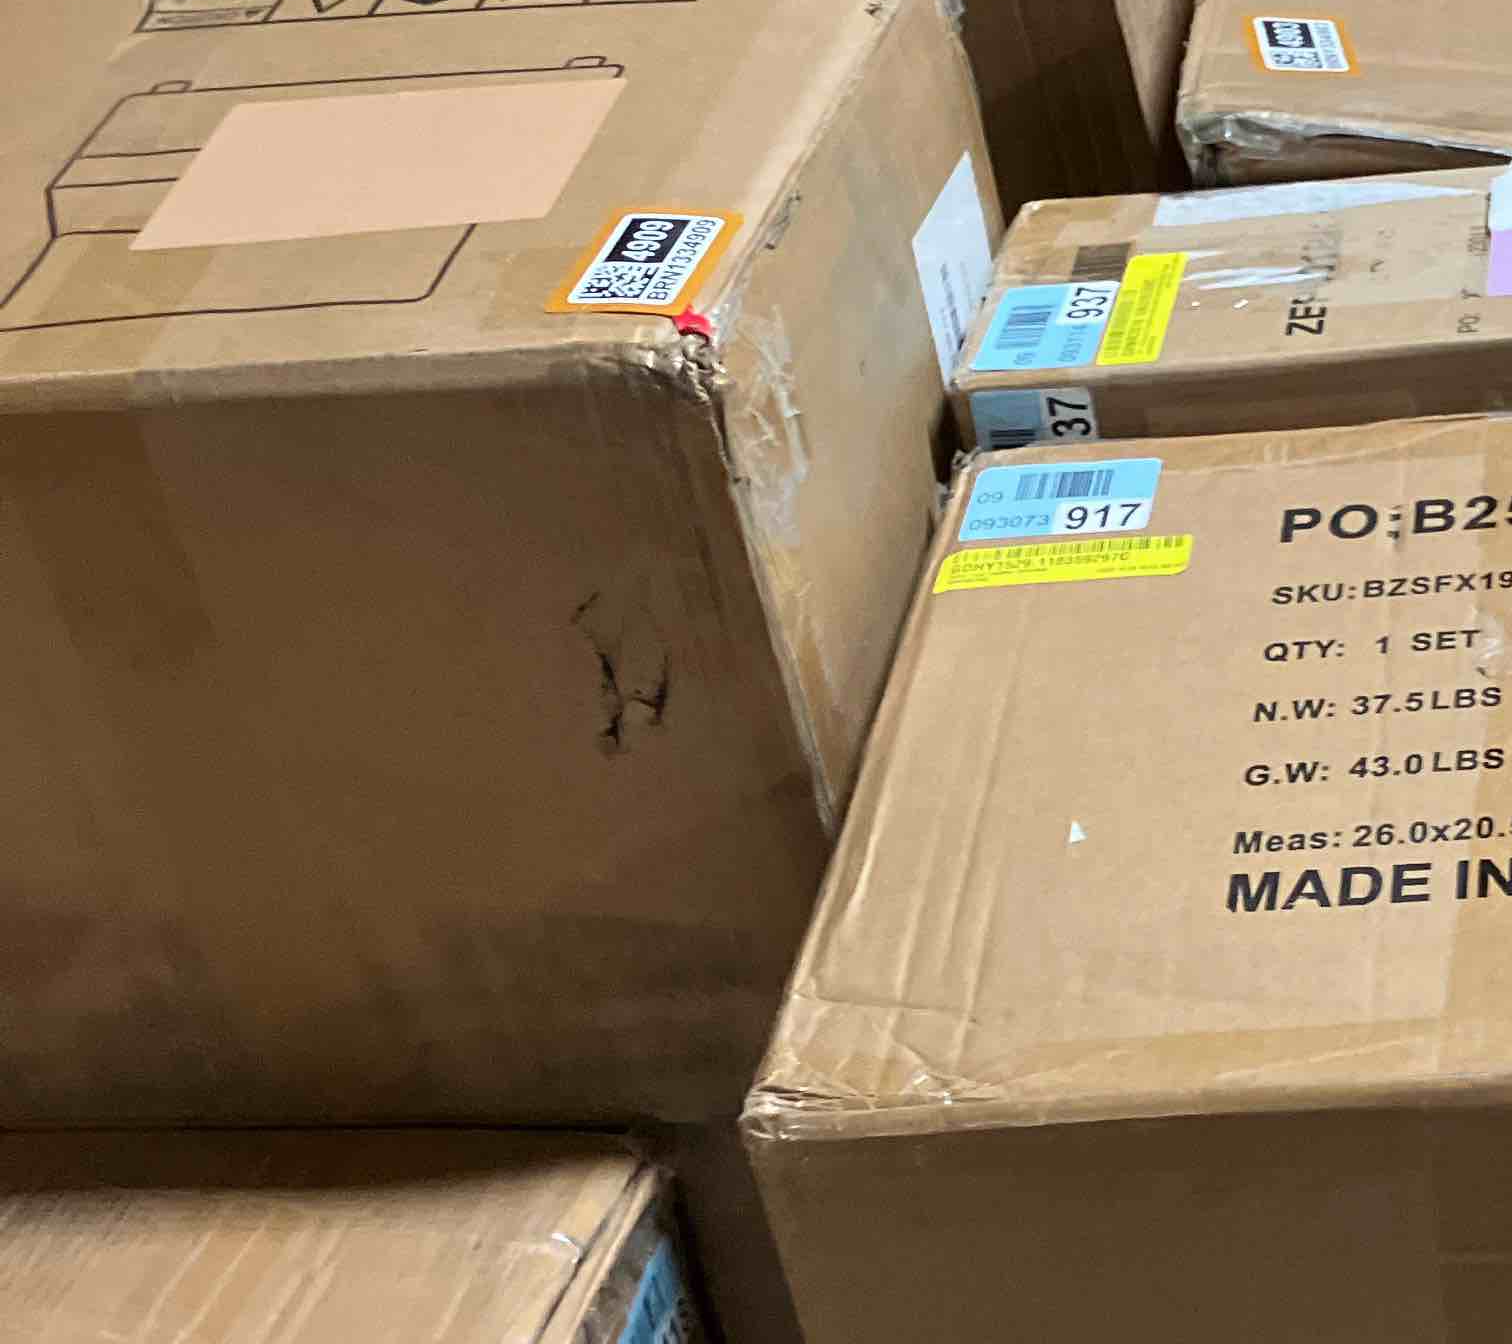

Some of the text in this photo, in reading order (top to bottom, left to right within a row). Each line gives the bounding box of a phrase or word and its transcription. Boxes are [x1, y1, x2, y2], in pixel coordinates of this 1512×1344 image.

[622, 220, 673, 261] 4909
[647, 219, 716, 300] BRN1334909
[1067, 287, 1109, 320] 937
[1047, 396, 1092, 438] 37
[1064, 502, 1142, 531] 917
[1263, 628, 1484, 663] QTY: 1 SET
[1252, 698, 1336, 723] N.W:
[1243, 760, 1330, 787] G.W:
[1232, 828, 1344, 856] Meas:
[1225, 862, 1433, 914] MADE
